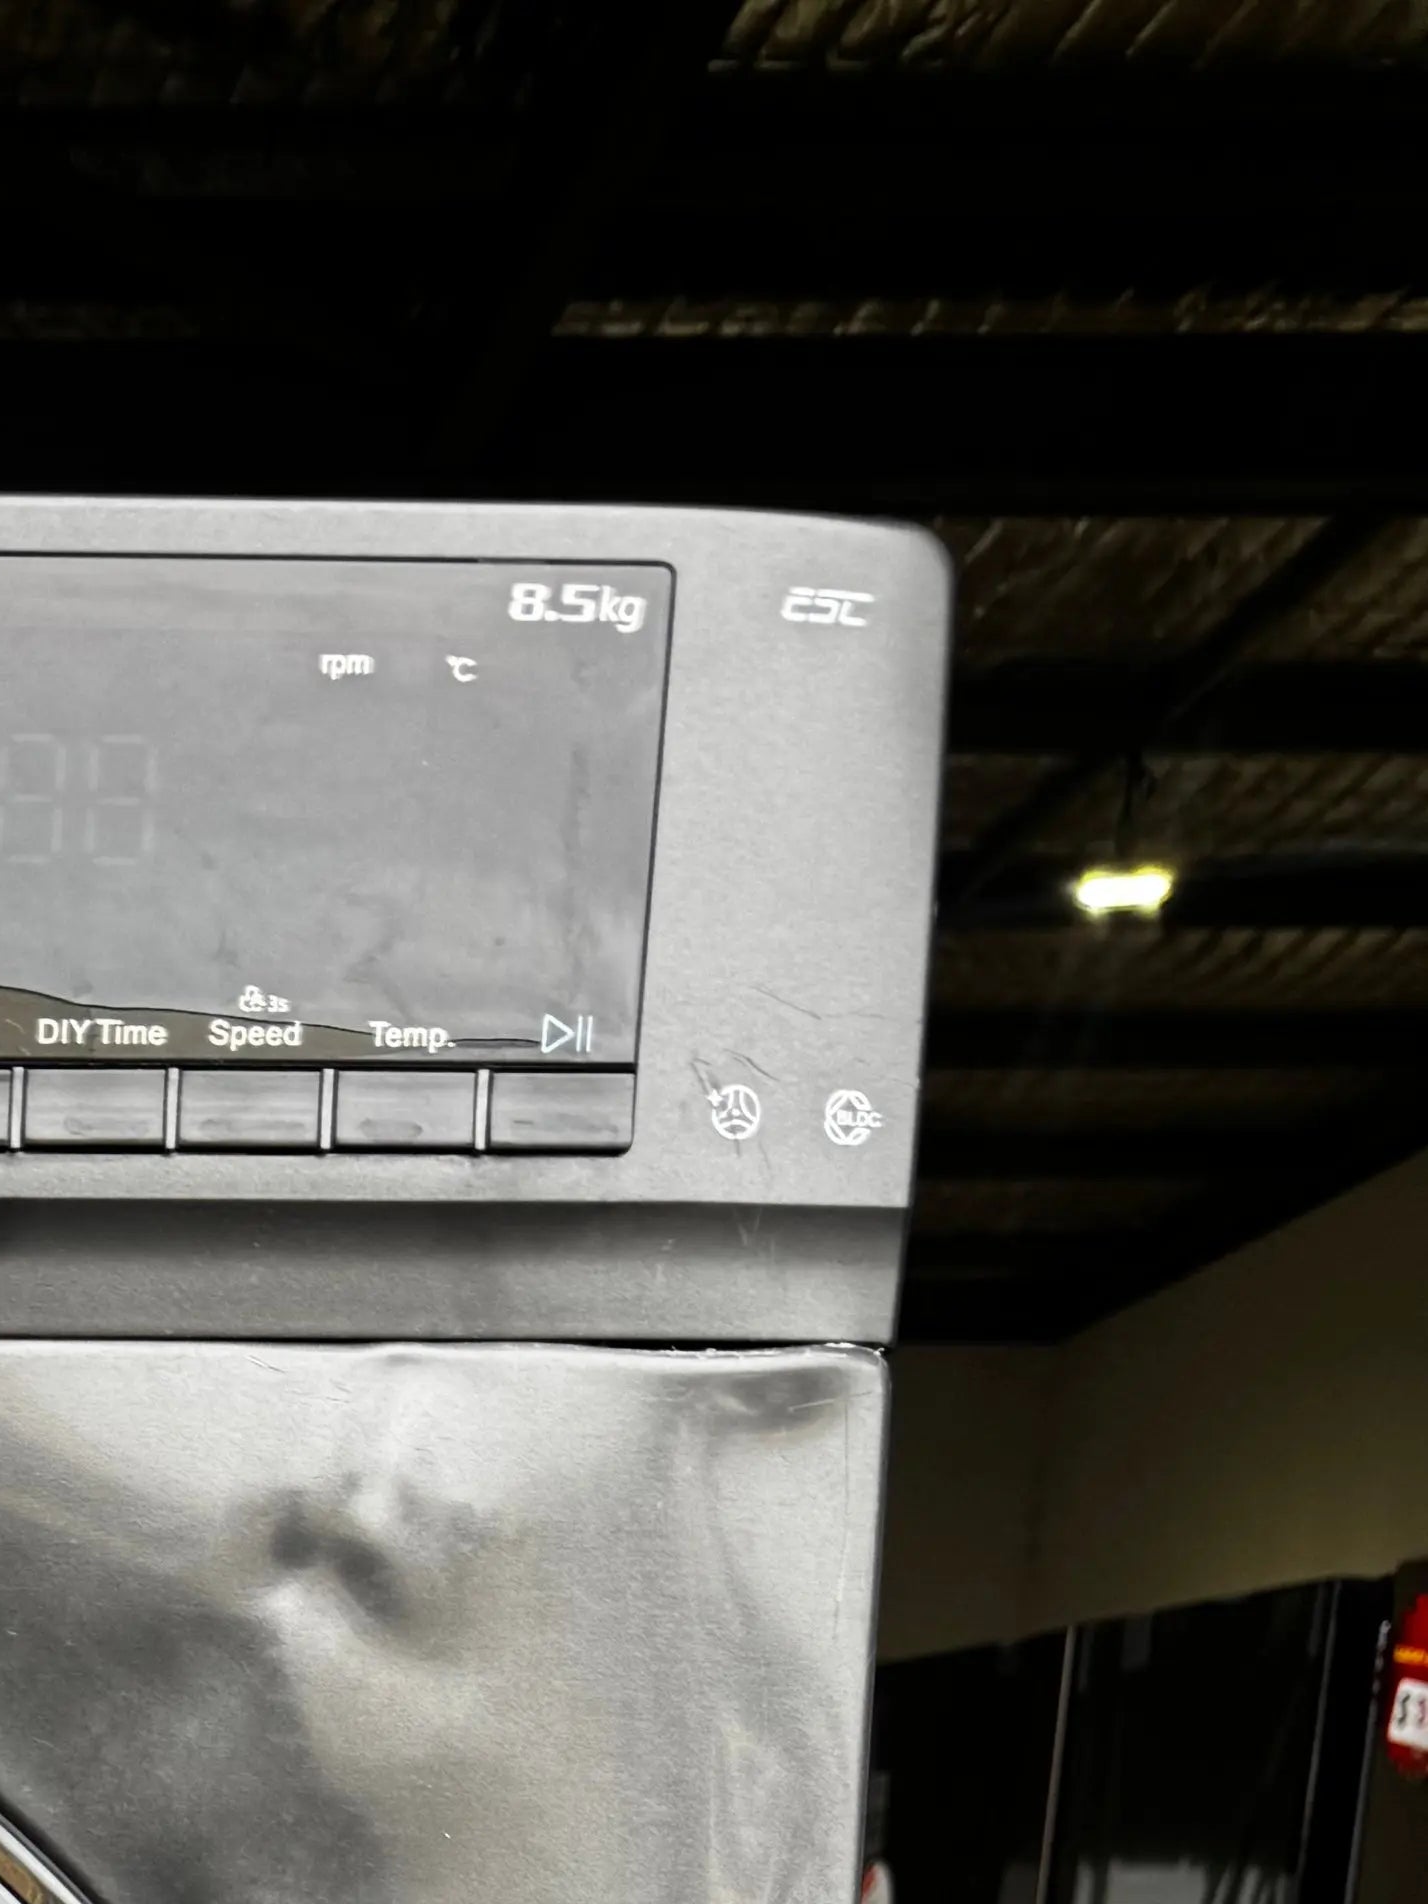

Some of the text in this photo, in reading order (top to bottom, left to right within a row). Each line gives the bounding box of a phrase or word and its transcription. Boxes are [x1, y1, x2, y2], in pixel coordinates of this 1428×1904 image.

[508, 582, 647, 633] 8.5kg
[320, 654, 374, 681] rpm
[37, 1019, 168, 1046] DIY Time
[208, 1021, 302, 1051] Speed
[368, 1021, 456, 1050] Temp.
